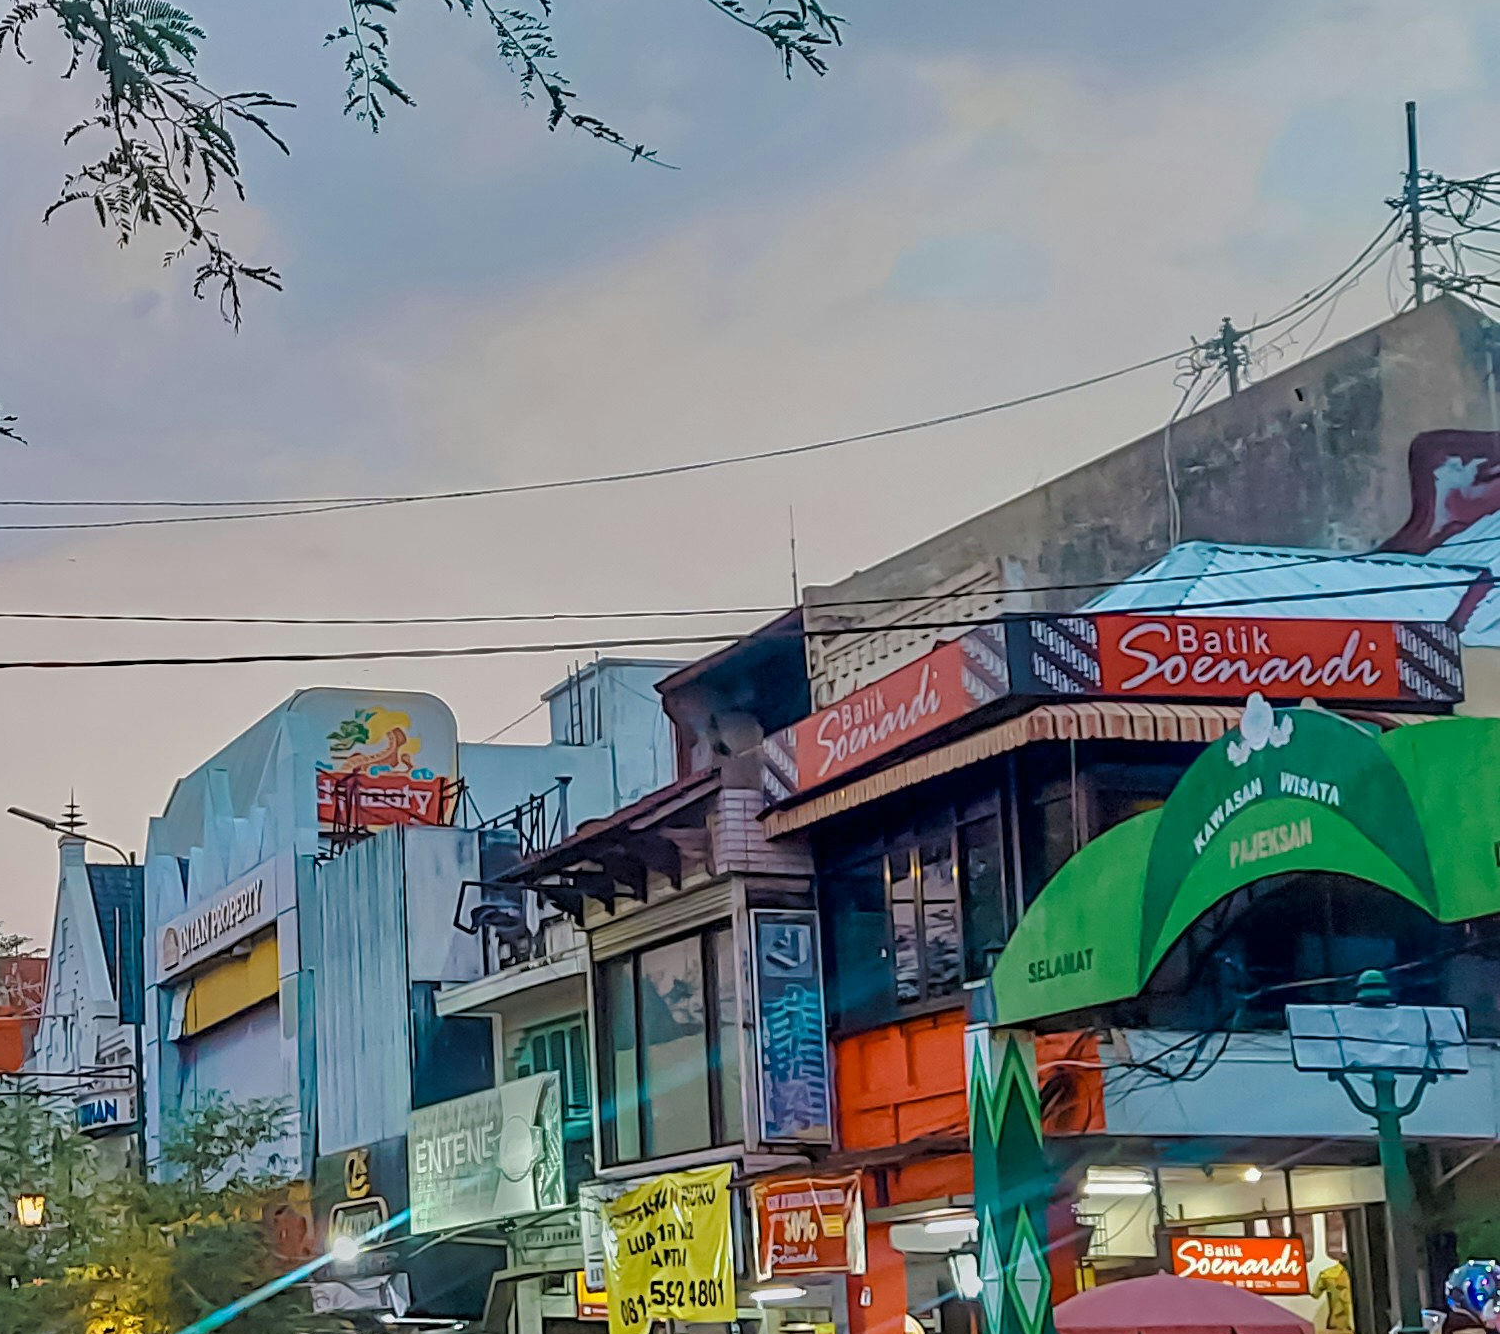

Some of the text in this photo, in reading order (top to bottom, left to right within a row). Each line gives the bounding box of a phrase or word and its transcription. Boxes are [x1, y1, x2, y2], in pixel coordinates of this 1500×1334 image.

[1118, 622, 1382, 691] Soenardi
[1177, 624, 1270, 655] Batik
[817, 663, 942, 778] Soenardi
[841, 687, 886, 731] Batik
[1193, 771, 1340, 855] KAWASAN WISATA
[1230, 816, 1312, 869] PAJEKSAN
[210, 879, 263, 939] PROPERTY
[1028, 948, 1093, 984] SELAMAT
[1176, 1239, 1302, 1278] Soenardi
[1203, 1243, 1243, 1258] Batik
